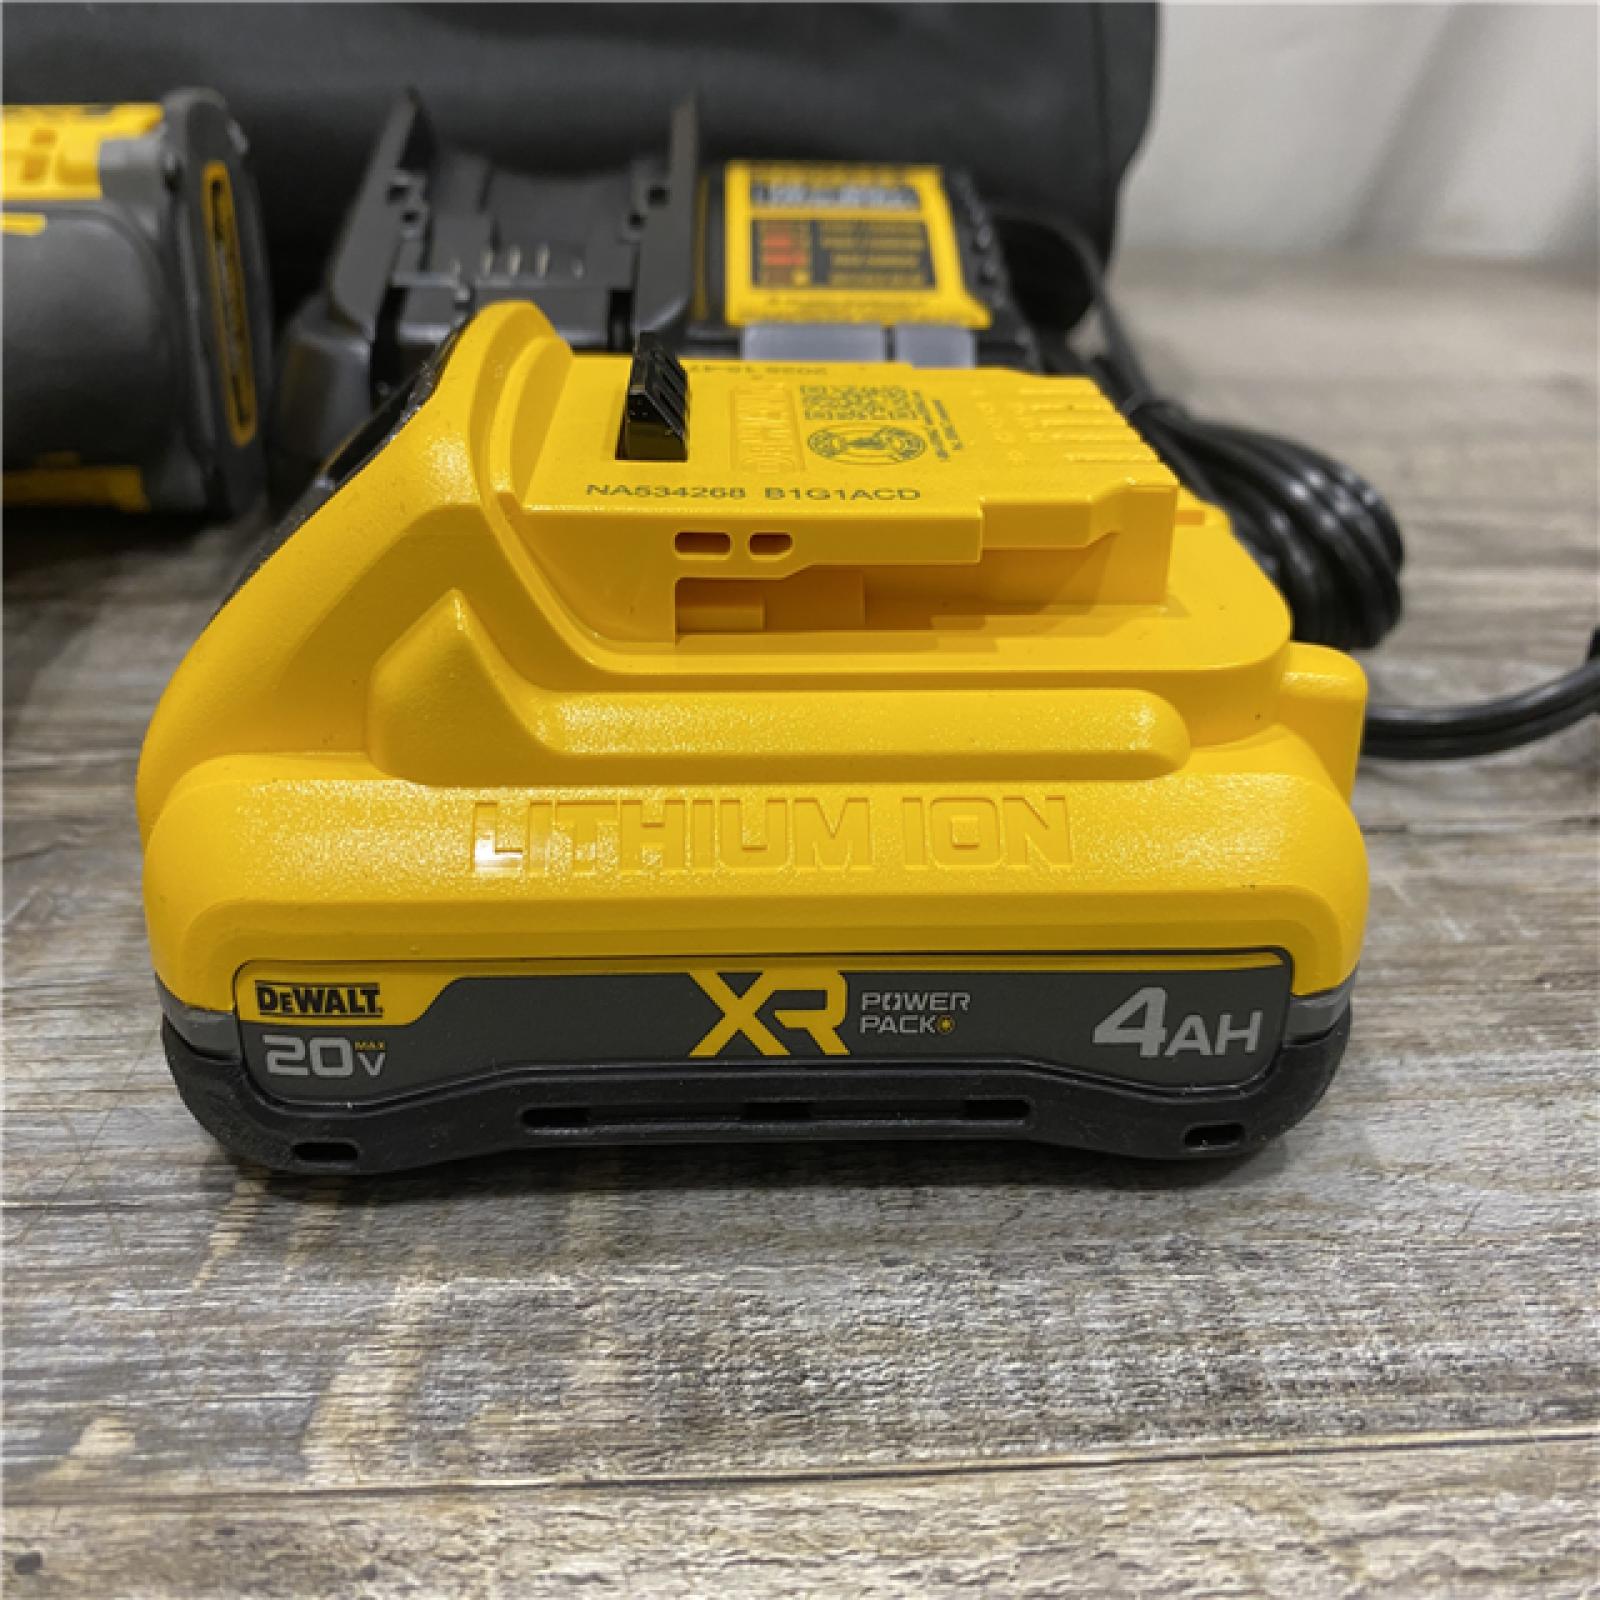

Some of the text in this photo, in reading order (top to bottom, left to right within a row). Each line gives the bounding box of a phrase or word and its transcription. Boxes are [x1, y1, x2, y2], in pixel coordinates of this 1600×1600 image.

[472, 794, 1073, 876] LITHIUM ION
[688, 969, 850, 1057] XR
[859, 1014, 936, 1034] PACK
[860, 991, 971, 1012] POWER
